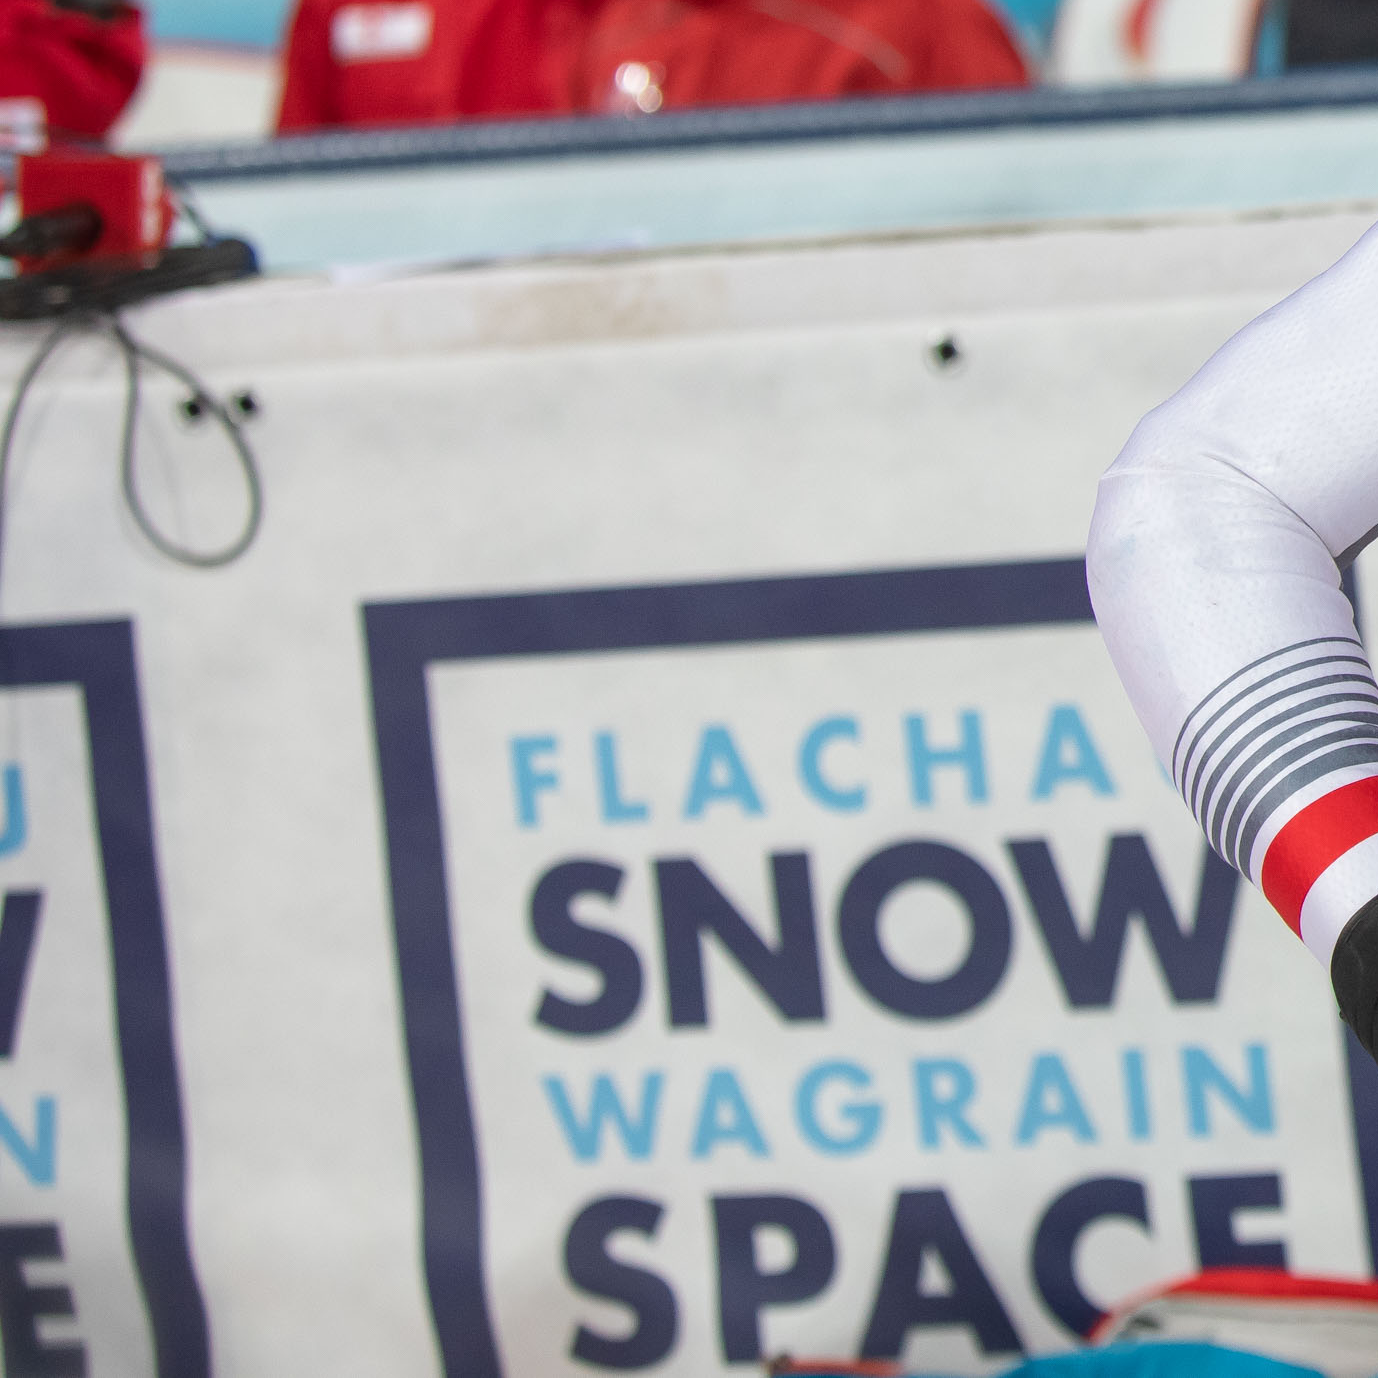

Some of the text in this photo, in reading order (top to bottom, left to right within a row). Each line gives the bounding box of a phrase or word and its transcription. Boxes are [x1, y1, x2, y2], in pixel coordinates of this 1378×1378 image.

[507, 702, 1176, 829] FLACHA
[528, 831, 1243, 1040] SNOW
[541, 1042, 1279, 1165] WAGRAIN
